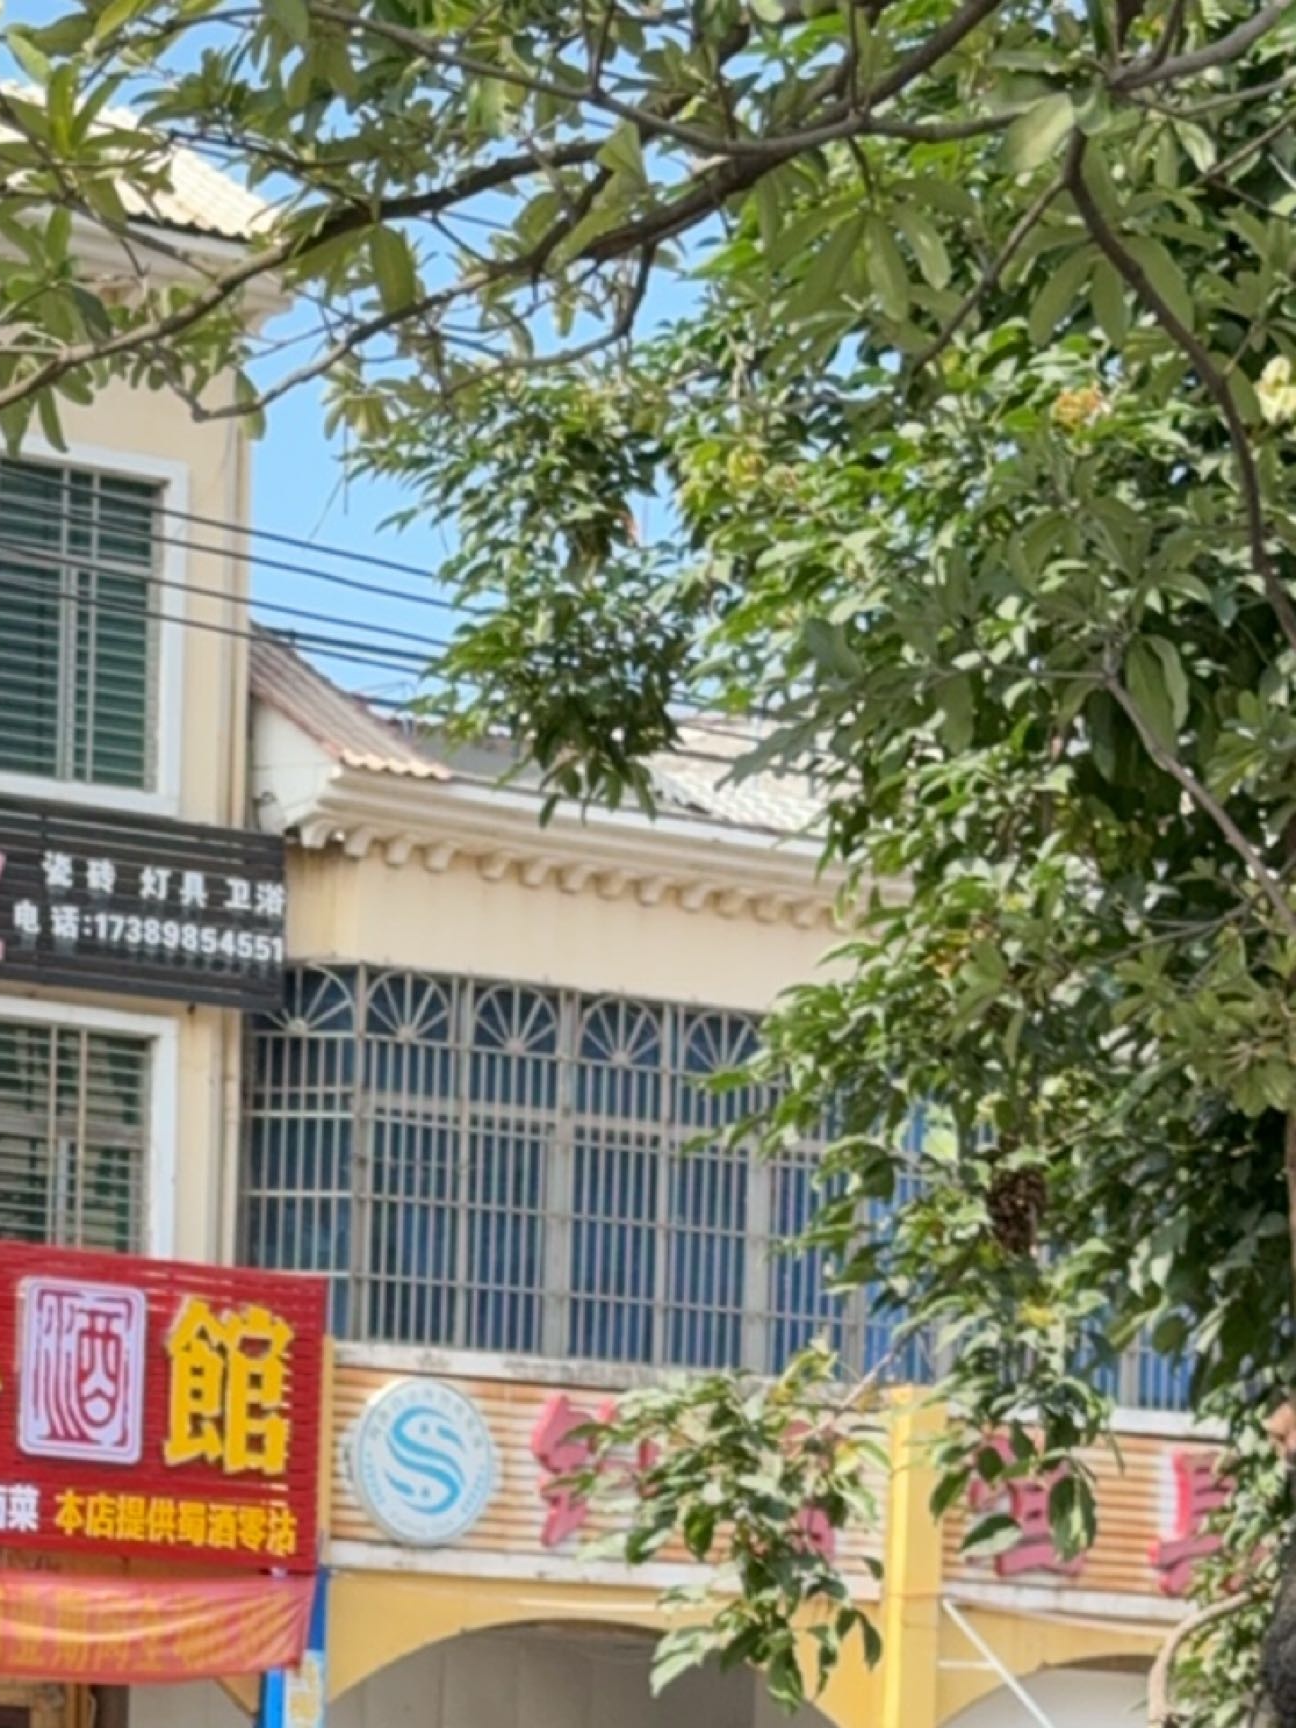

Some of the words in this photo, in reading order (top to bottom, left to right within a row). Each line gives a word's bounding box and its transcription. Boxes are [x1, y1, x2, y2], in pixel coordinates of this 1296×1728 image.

[42, 849, 116, 894] 瓷砖
[139, 865, 208, 909] 灯具
[223, 877, 285, 916] 卫浴
